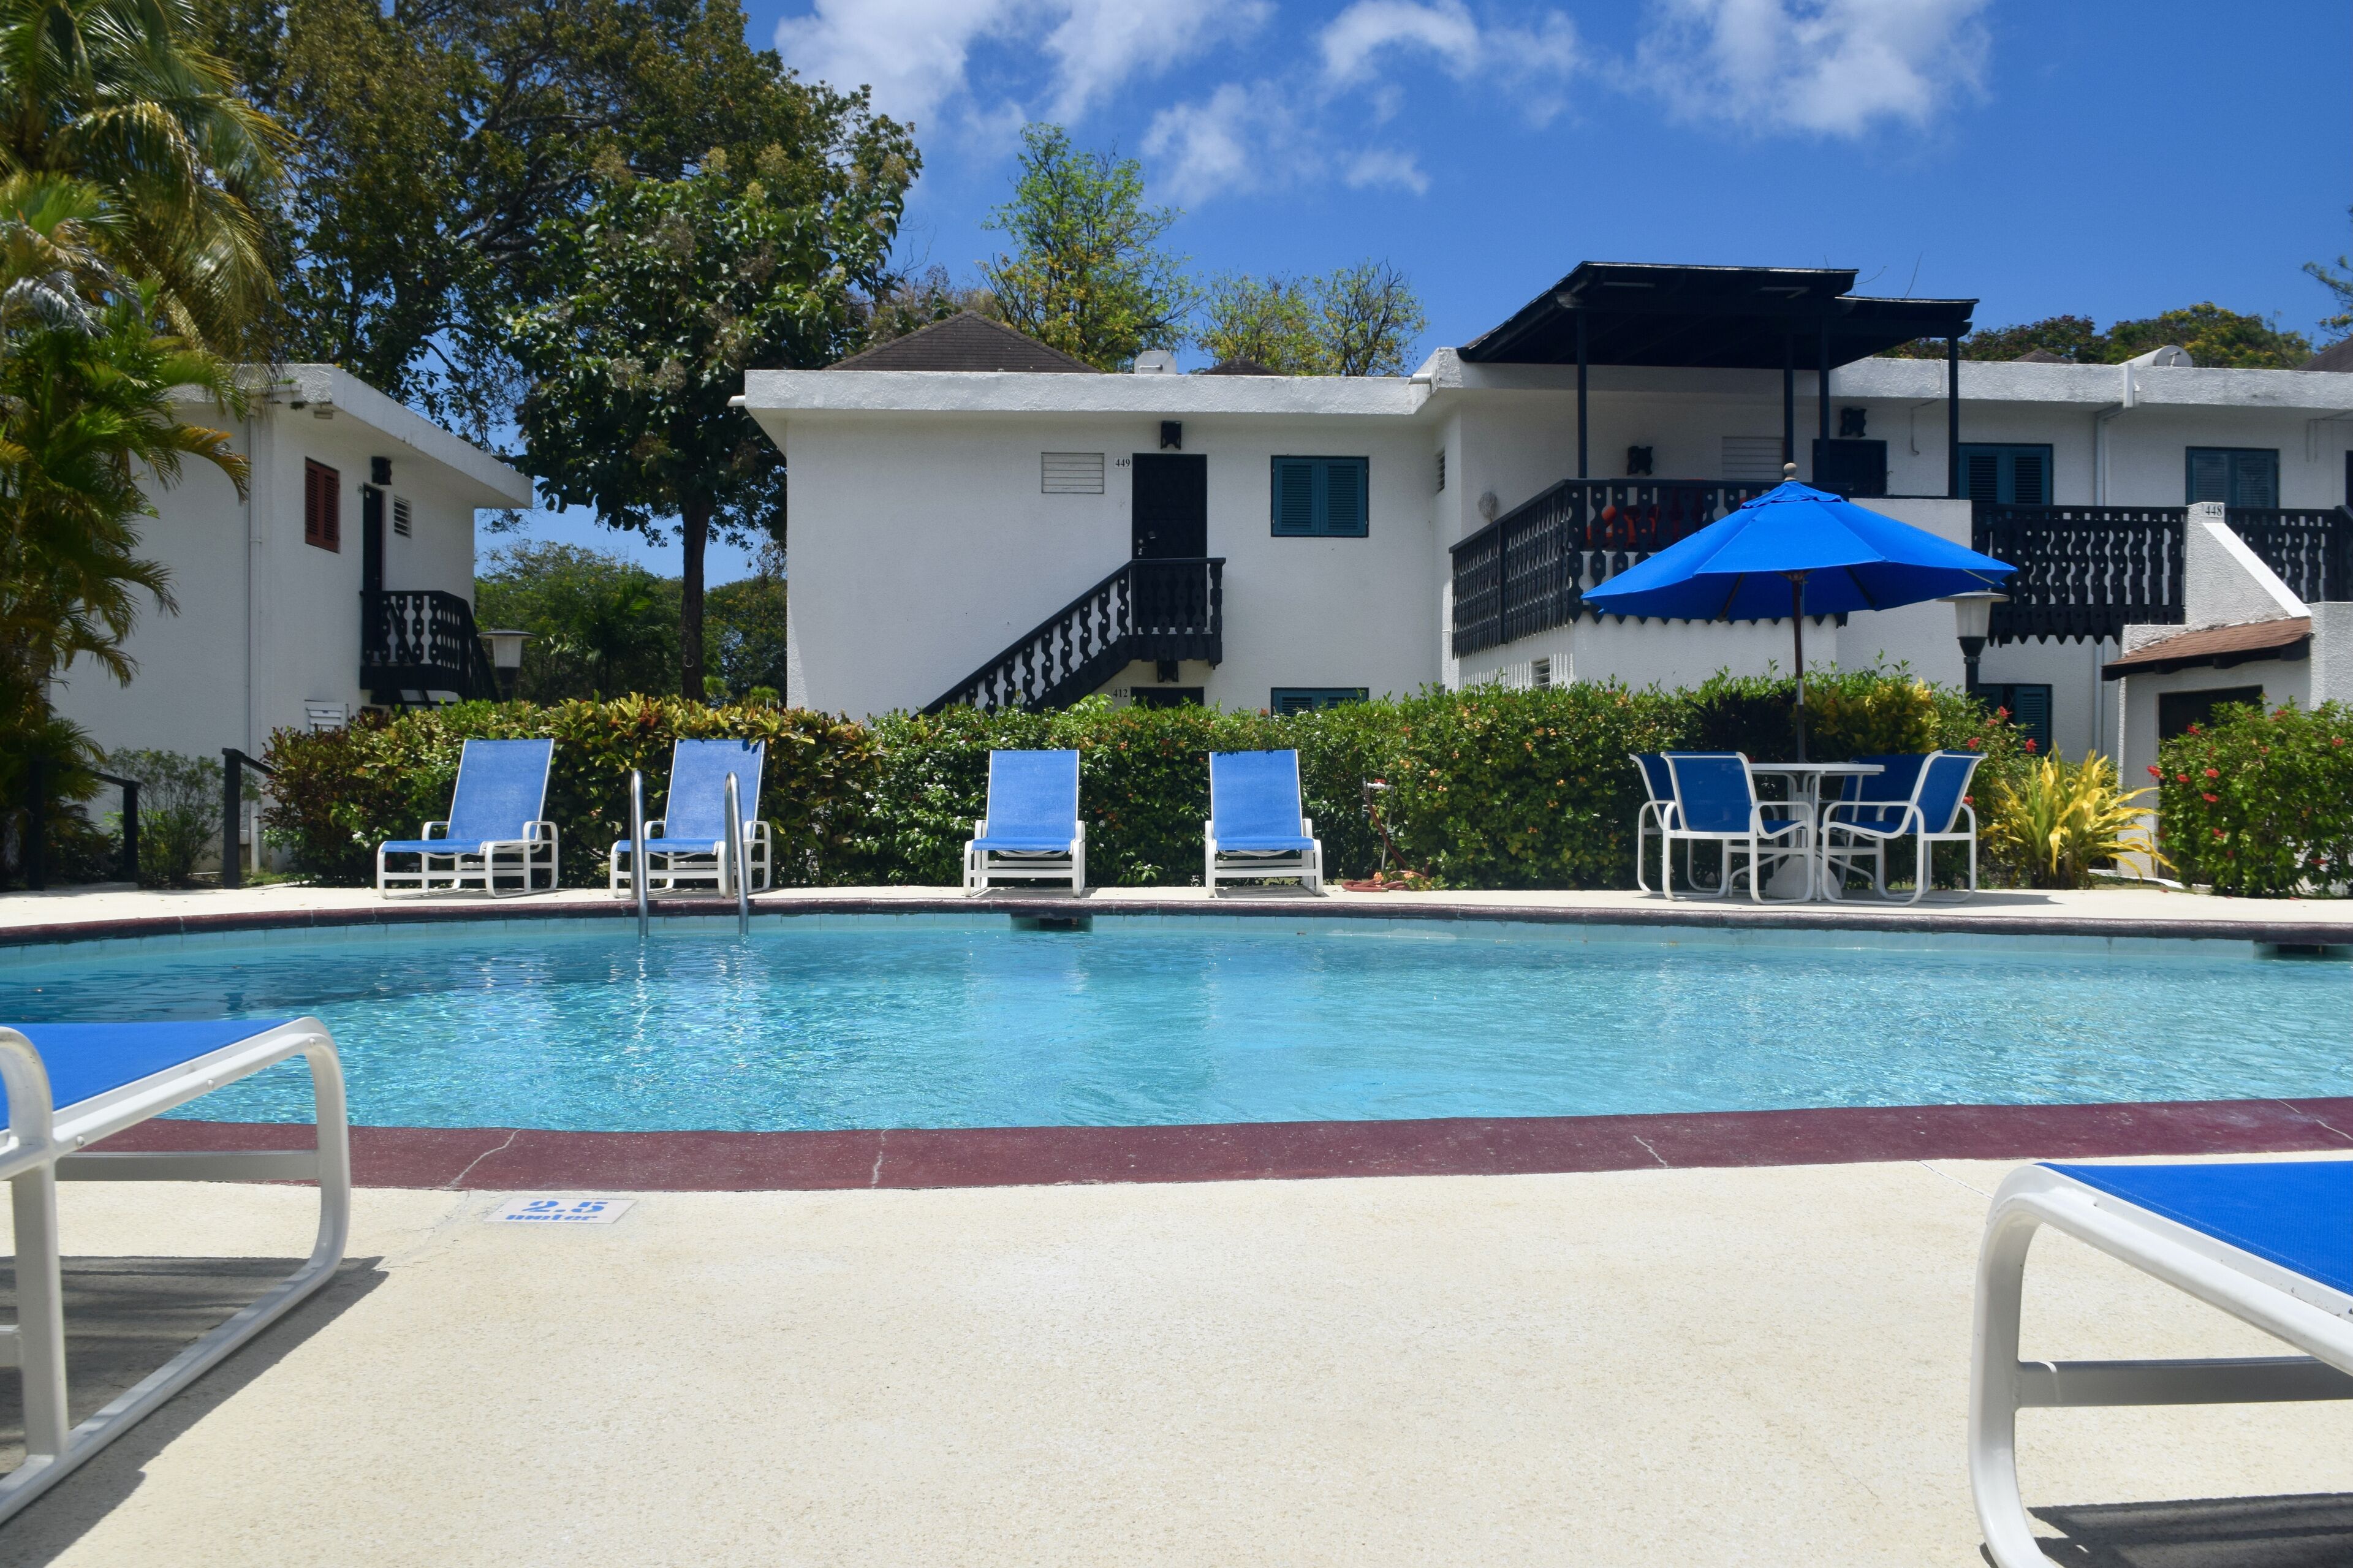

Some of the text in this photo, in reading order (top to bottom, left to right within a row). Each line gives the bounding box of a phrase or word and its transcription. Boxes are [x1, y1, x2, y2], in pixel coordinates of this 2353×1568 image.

[1115, 458, 1130, 467] 449
[2205, 505, 2222, 516] 448
[1113, 688, 1127, 697] 412
[521, 1200, 608, 1213] 2.5
